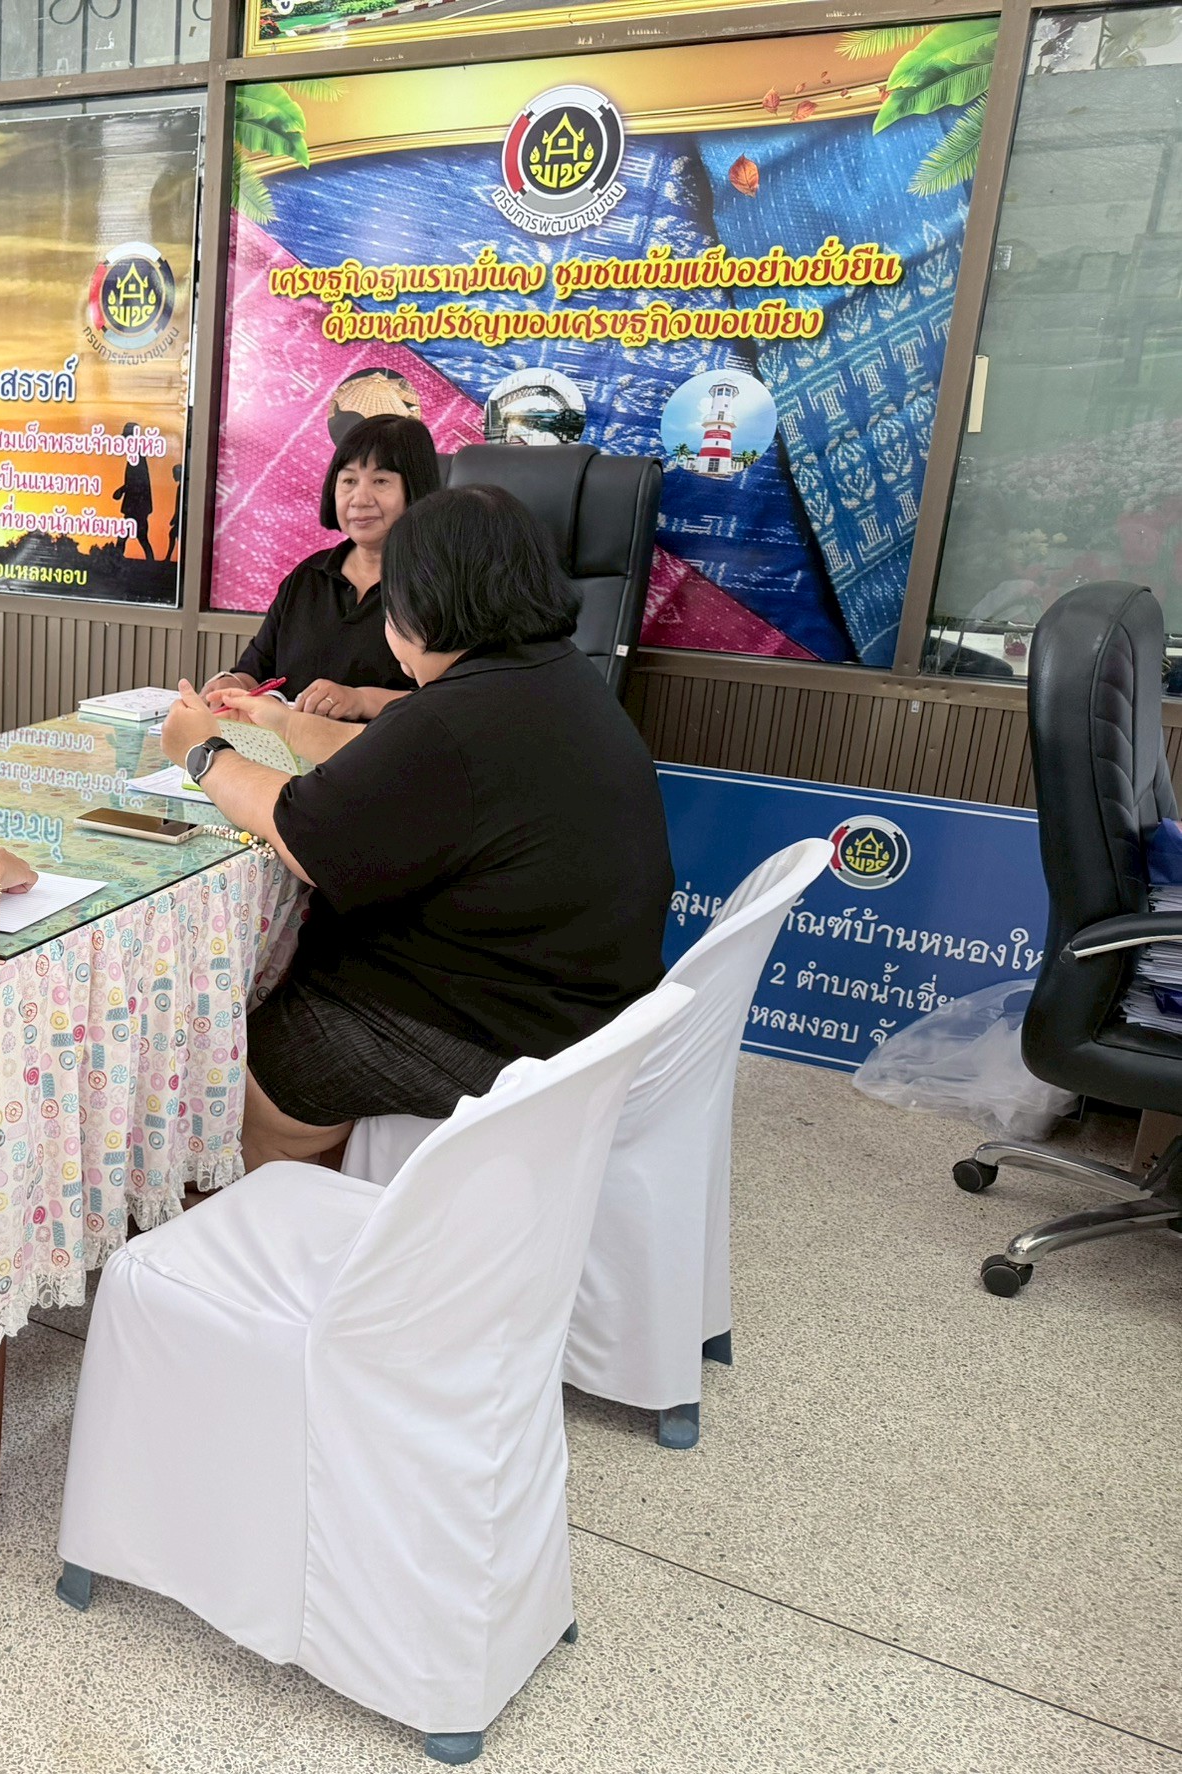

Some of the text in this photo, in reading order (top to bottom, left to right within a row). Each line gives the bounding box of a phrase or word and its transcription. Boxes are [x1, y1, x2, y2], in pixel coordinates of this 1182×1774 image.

[493, 184, 624, 233] กรมการพัฒนาชุมชน
[270, 239, 899, 298] เศรษฐกิจฐานรากมั่นคง ชุมชนเข้มแข็งอย่างยั่งยืน
[325, 301, 820, 342] ด้วยหลักปรัชญาของเศรษฐกิจพอเพียง
[83, 326, 180, 366] กรมการพัฒนาชุมชน
[769, 962, 787, 985] 2
[746, 1004, 859, 1044] หลมงอบ
